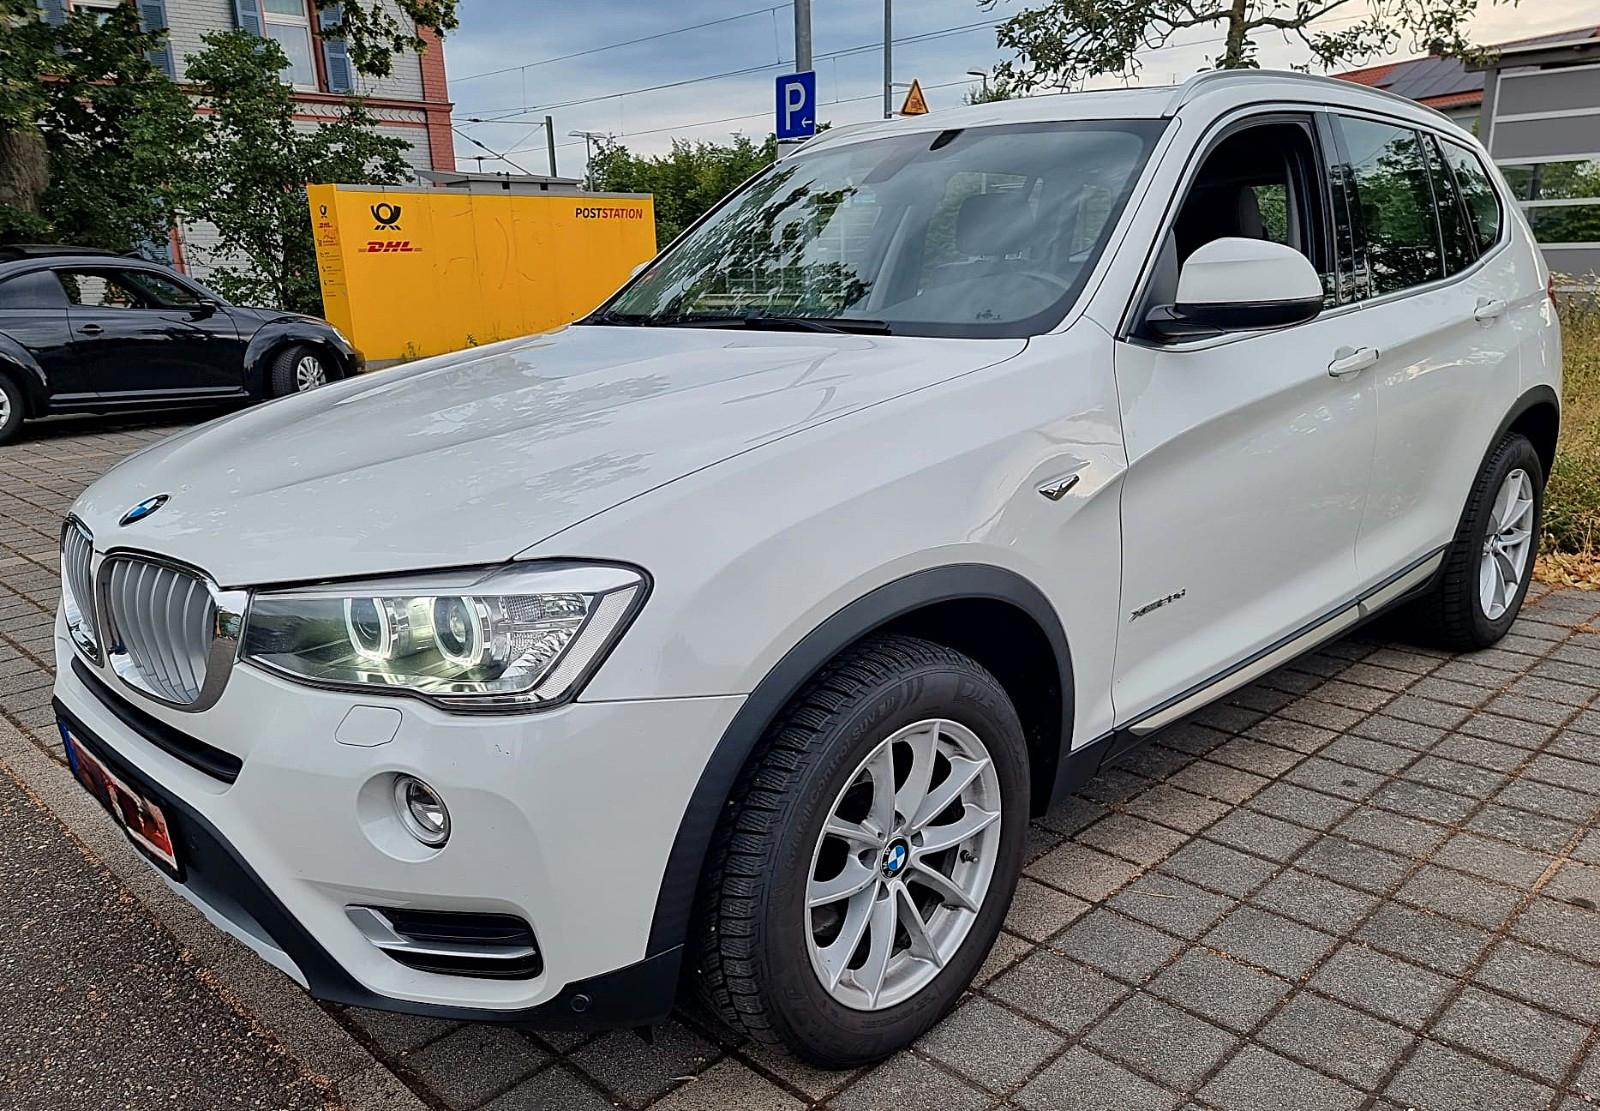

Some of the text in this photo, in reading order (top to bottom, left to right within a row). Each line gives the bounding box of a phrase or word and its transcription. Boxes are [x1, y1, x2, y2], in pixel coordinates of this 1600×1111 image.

[785, 82, 806, 131] P
[575, 207, 643, 219] POSTSTATION
[367, 240, 414, 253] DHL
